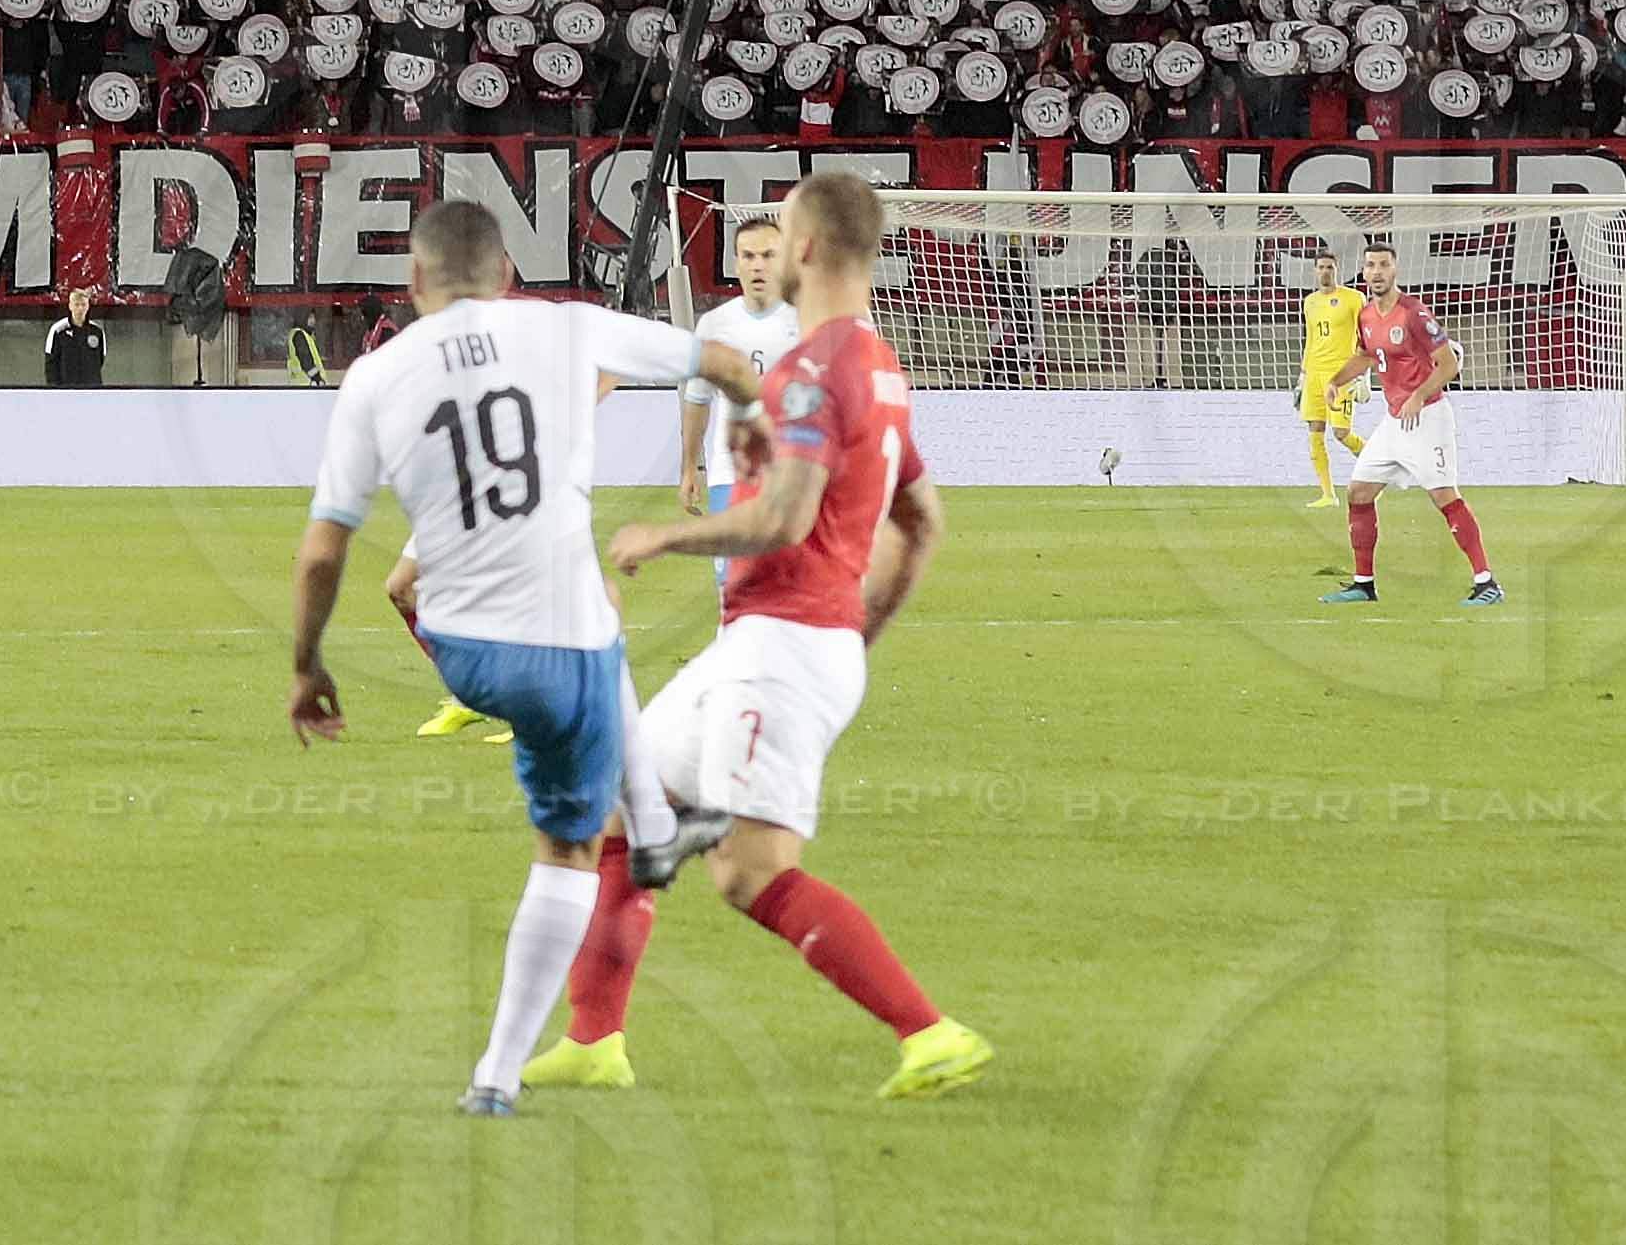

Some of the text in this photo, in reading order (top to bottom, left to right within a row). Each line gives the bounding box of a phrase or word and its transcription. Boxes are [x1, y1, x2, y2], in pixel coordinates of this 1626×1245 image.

[1316, 320, 1330, 337] 13
[437, 333, 499, 373] TIBI
[1375, 347, 1387, 373] 3
[424, 385, 541, 531] 19
[1433, 446, 1445, 468] 3
[738, 708, 763, 764] 7
